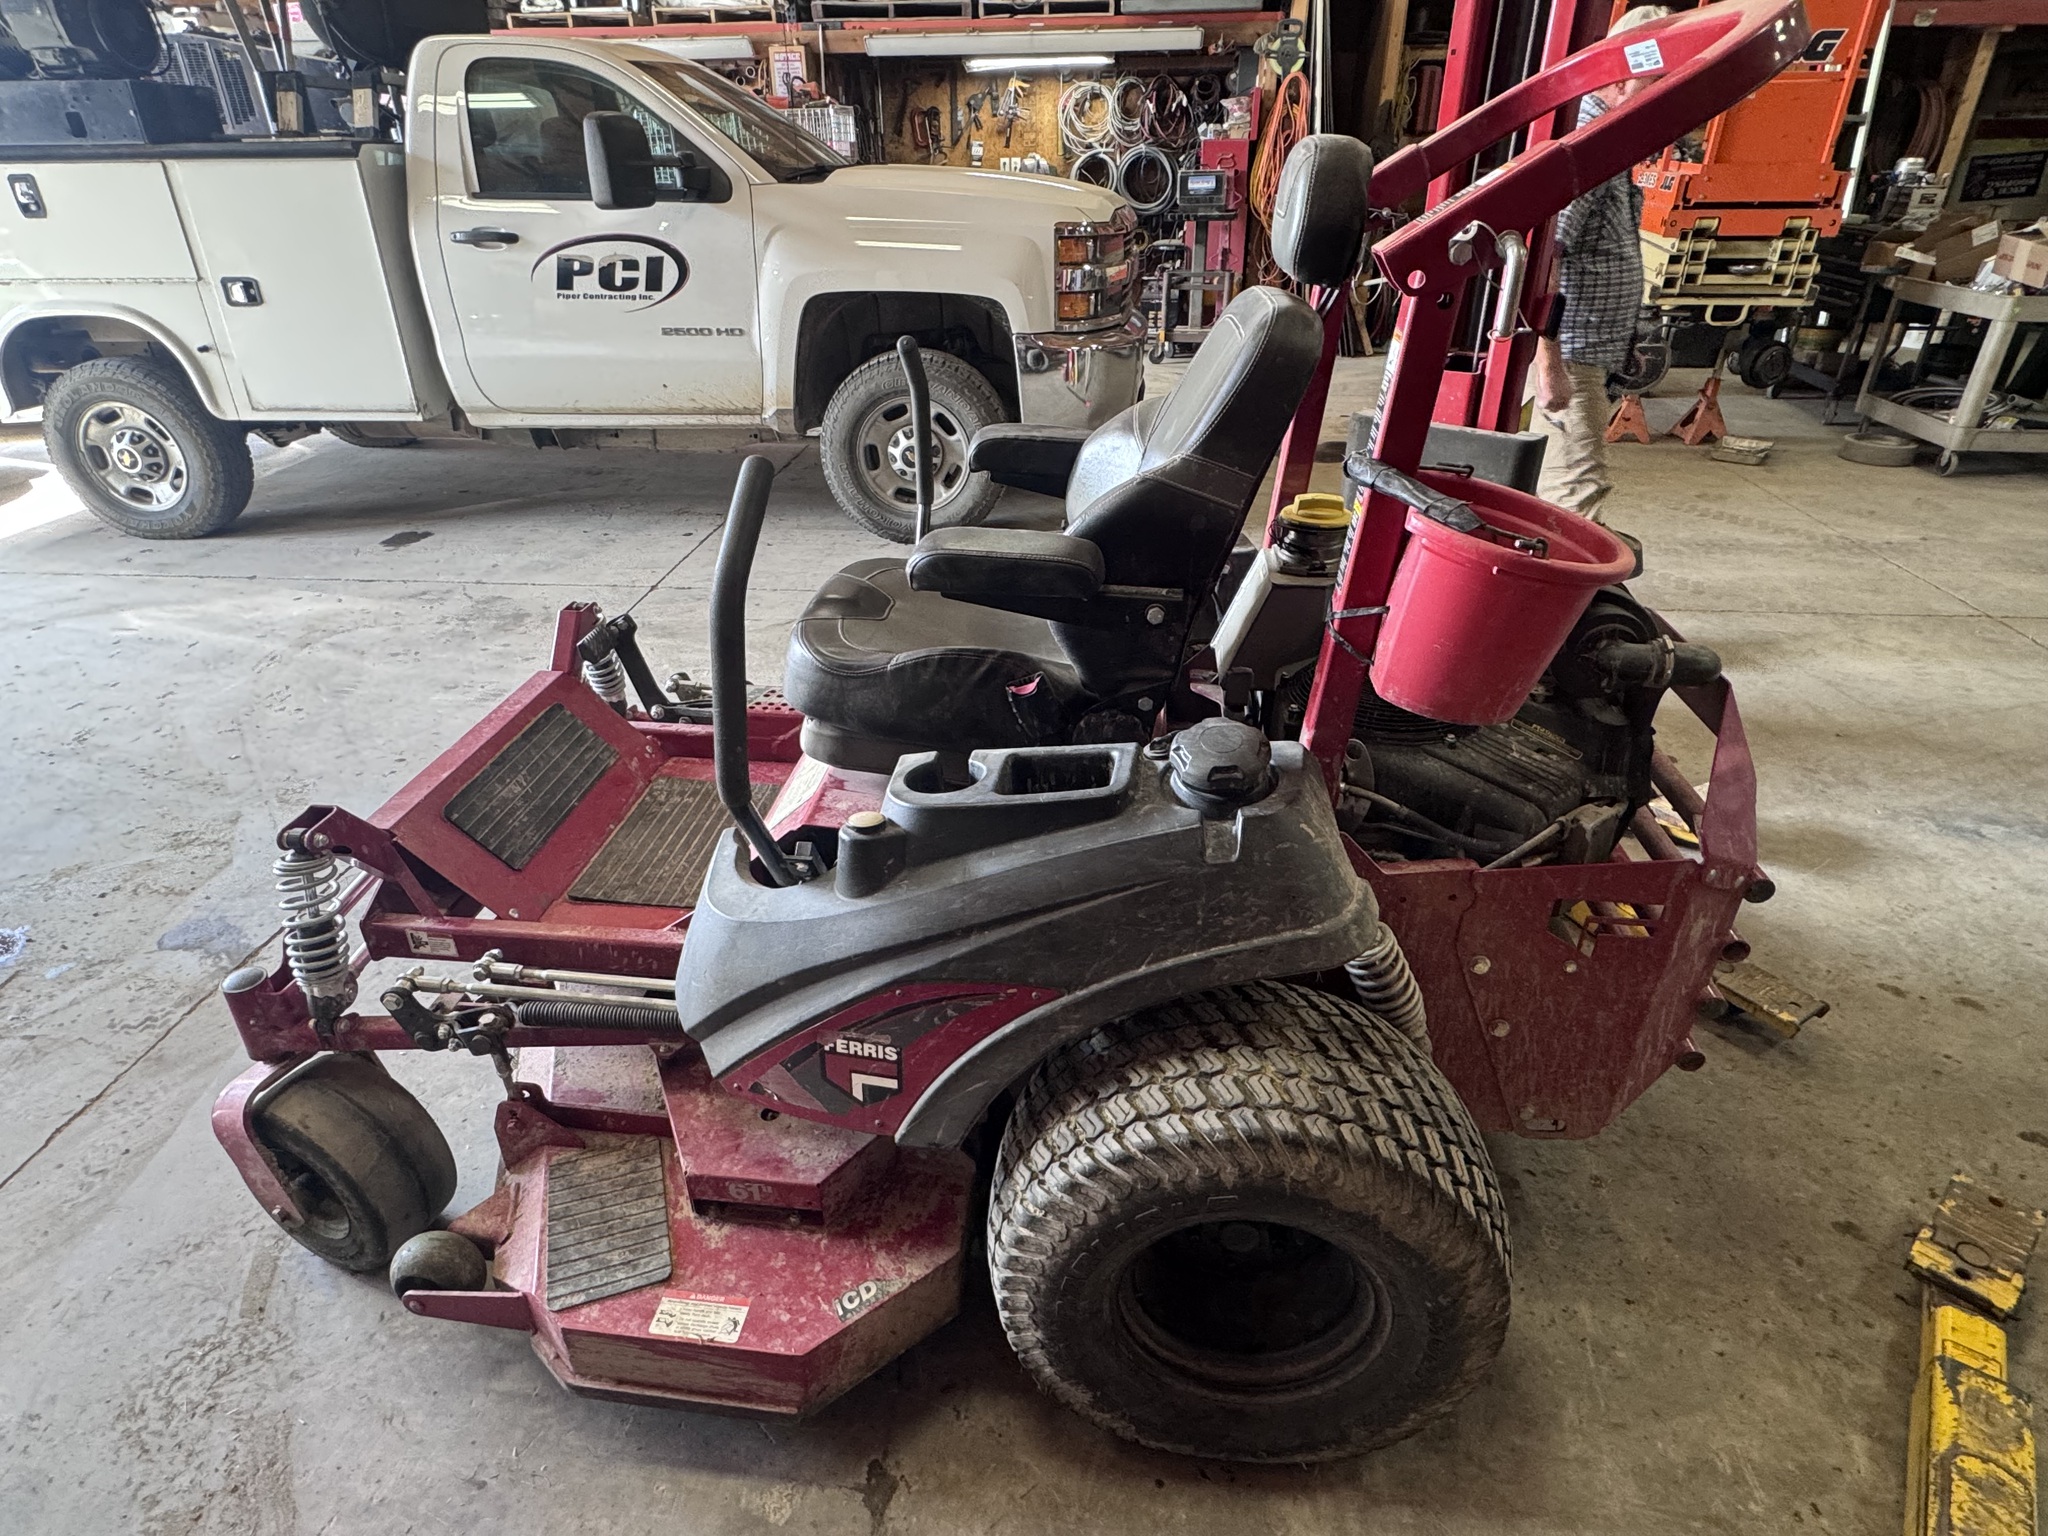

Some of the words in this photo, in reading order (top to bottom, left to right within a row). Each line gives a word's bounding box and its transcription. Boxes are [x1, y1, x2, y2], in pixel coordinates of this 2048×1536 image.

[556, 253, 665, 293] PCI
[556, 292, 581, 301] Piper
[582, 292, 637, 301] Contracting
[639, 293, 656, 301] Inc.
[661, 327, 713, 337] 2500
[716, 327, 745, 337] HD
